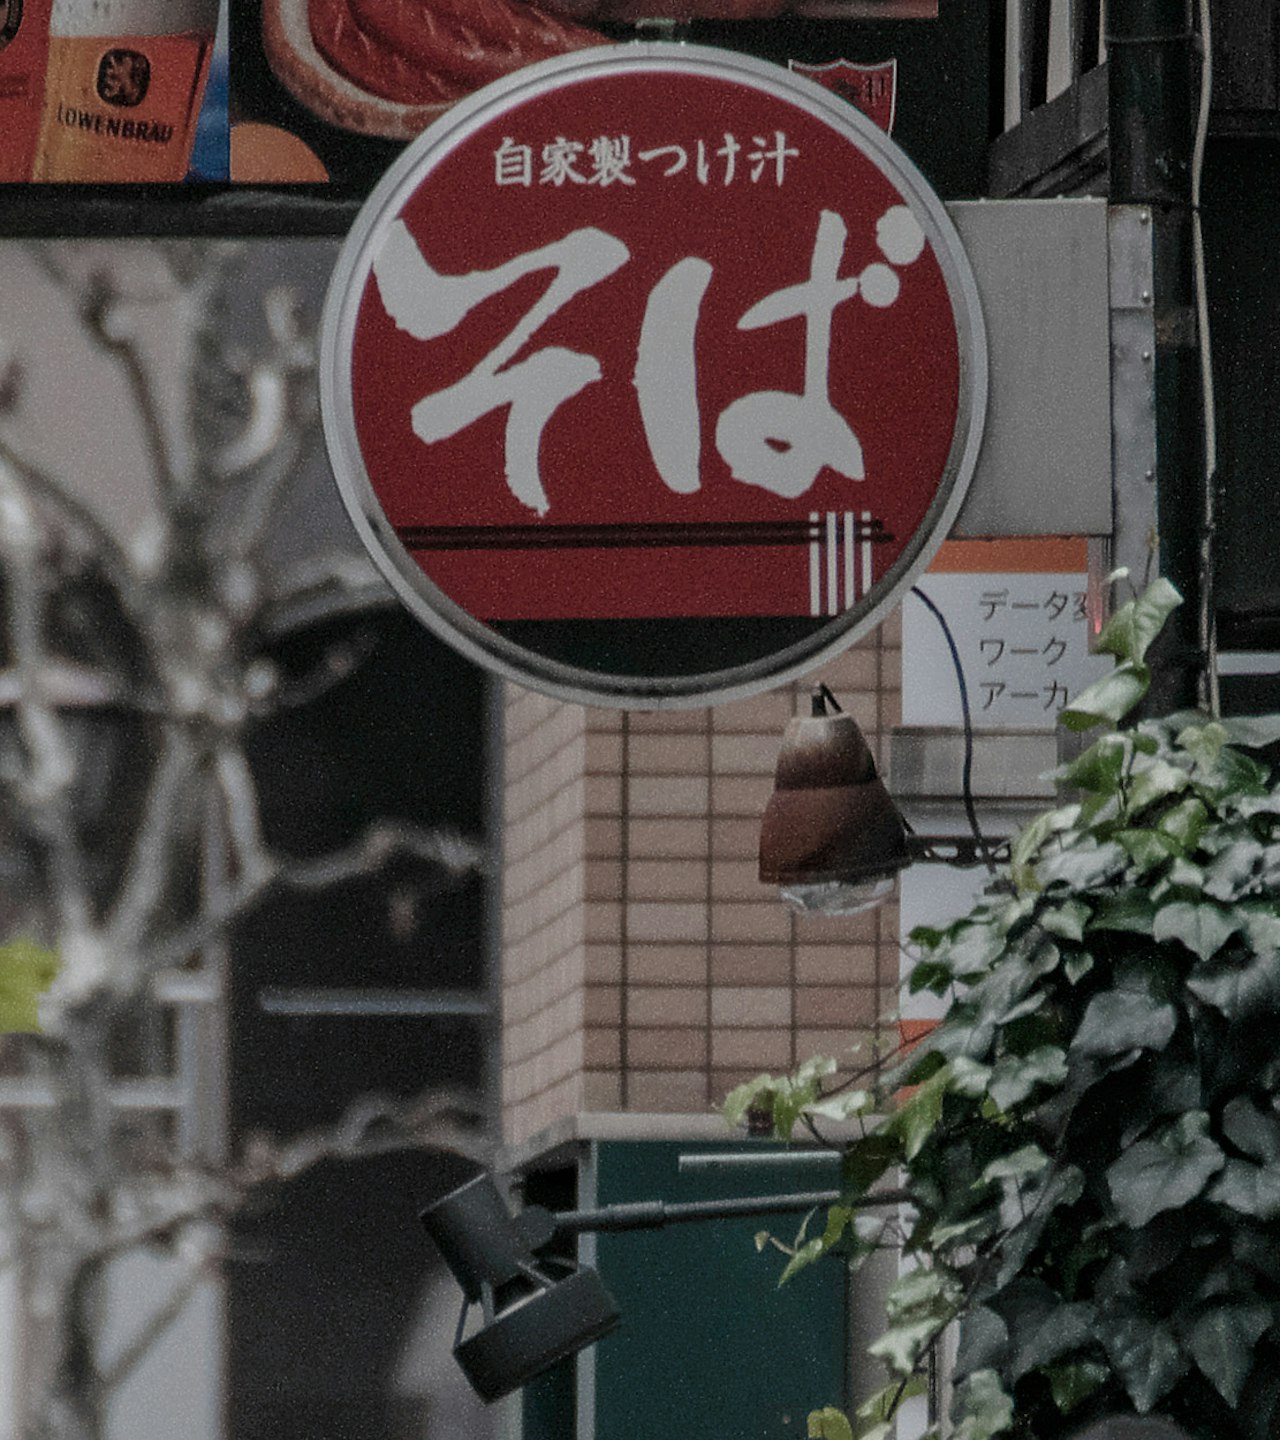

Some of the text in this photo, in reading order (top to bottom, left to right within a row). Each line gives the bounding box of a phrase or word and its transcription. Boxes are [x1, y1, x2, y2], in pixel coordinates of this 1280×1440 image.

[491, 131, 800, 188] 自家製つけ汁
[371, 204, 928, 517] そば
[979, 637, 1068, 667] ワーク
